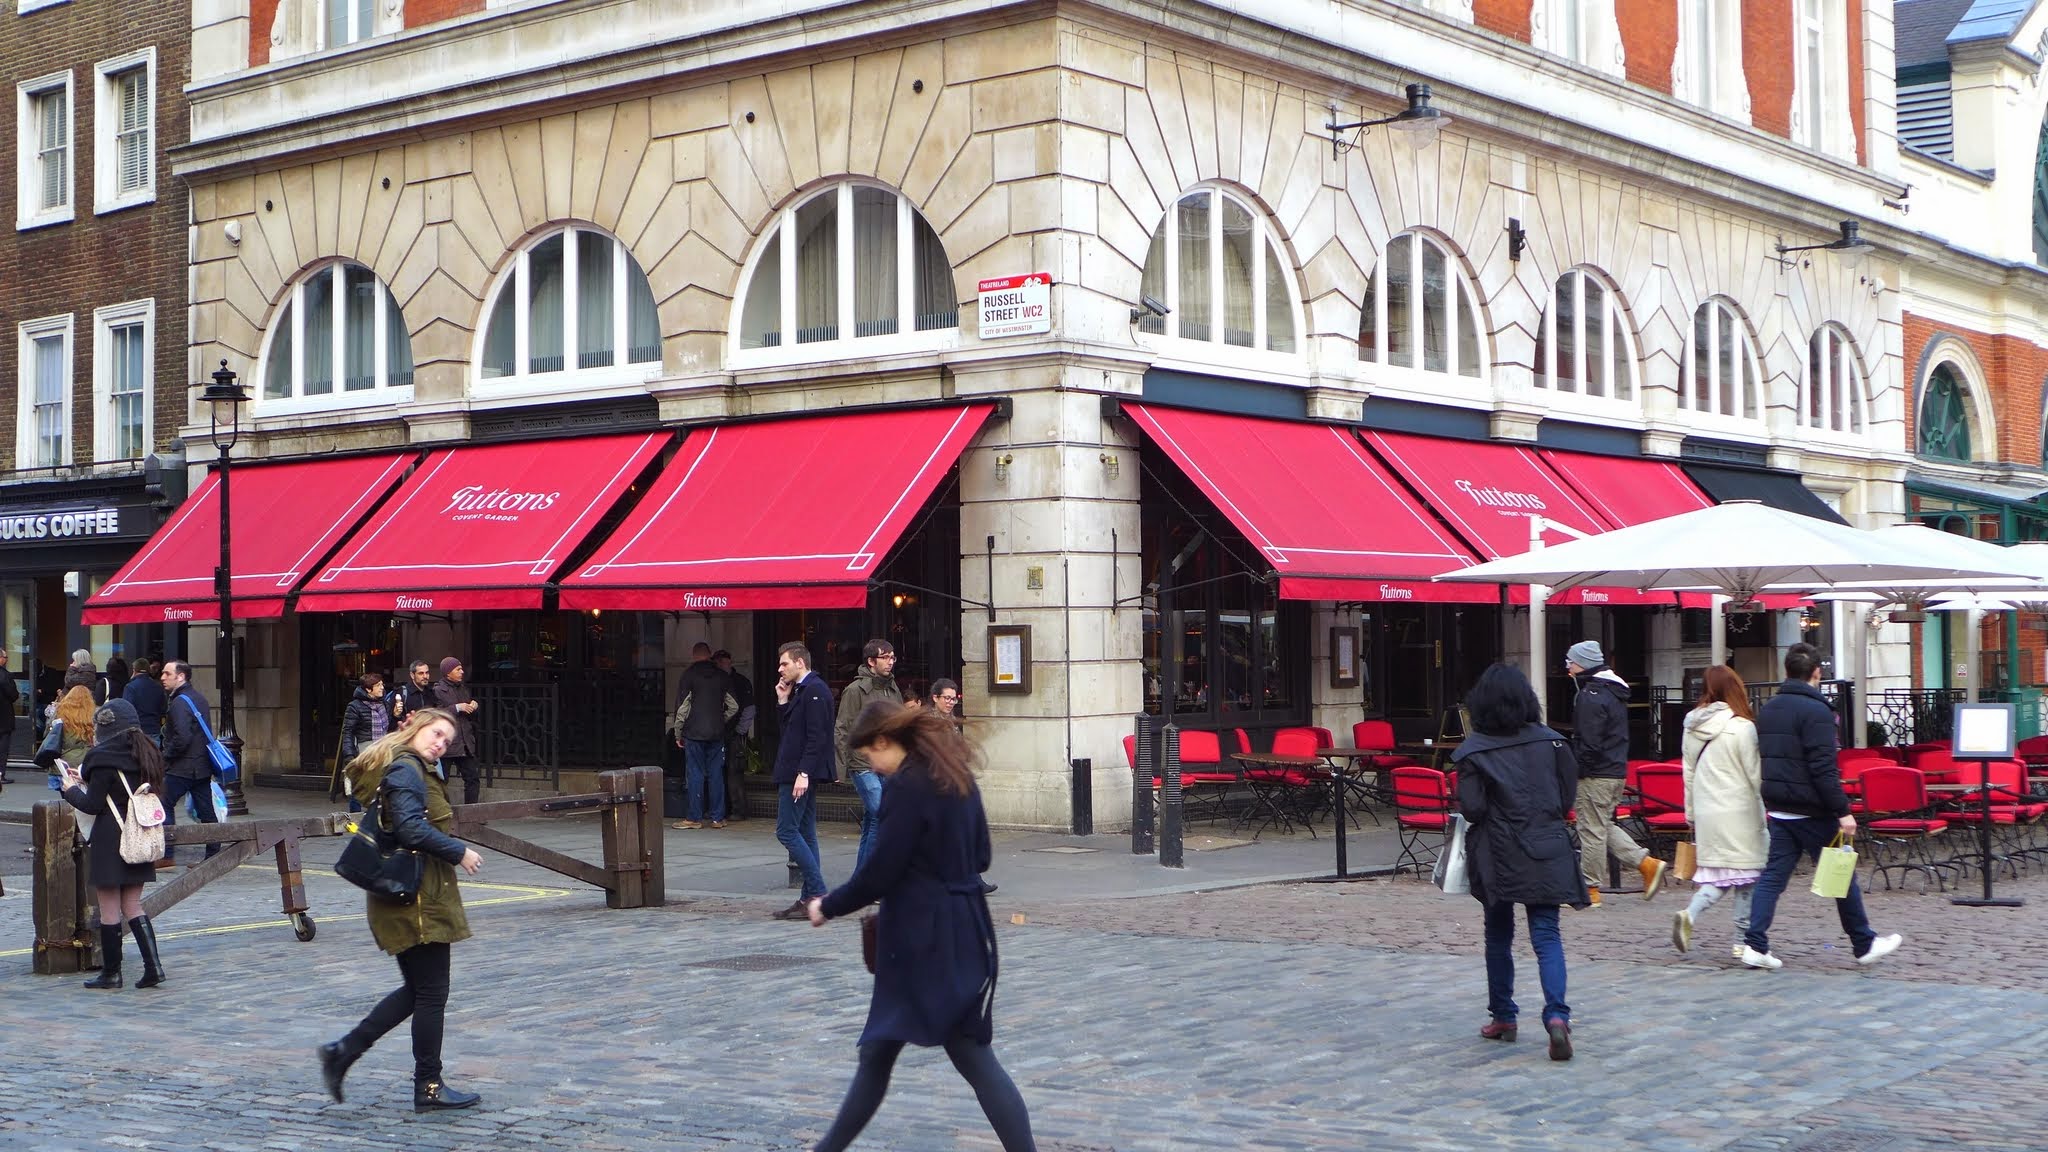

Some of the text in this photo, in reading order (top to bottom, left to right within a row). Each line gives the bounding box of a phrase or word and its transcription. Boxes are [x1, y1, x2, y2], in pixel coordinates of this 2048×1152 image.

[980, 280, 1010, 289] THEATRELAND
[984, 292, 1025, 308] RUSSELL
[984, 305, 1043, 322] STREET WC2
[1002, 325, 1032, 333] WESTMINSTER
[440, 485, 560, 514] Tuttons
[1454, 480, 1546, 509] Tuttons
[452, 513, 519, 521] COVENT GARDEN
[0, 512, 118, 540] UCKS COFFEE
[1380, 584, 1412, 599] Tuttons
[395, 595, 433, 609] Tuttons
[683, 592, 727, 608] Tuttons
[164, 607, 193, 620] Tuttons
